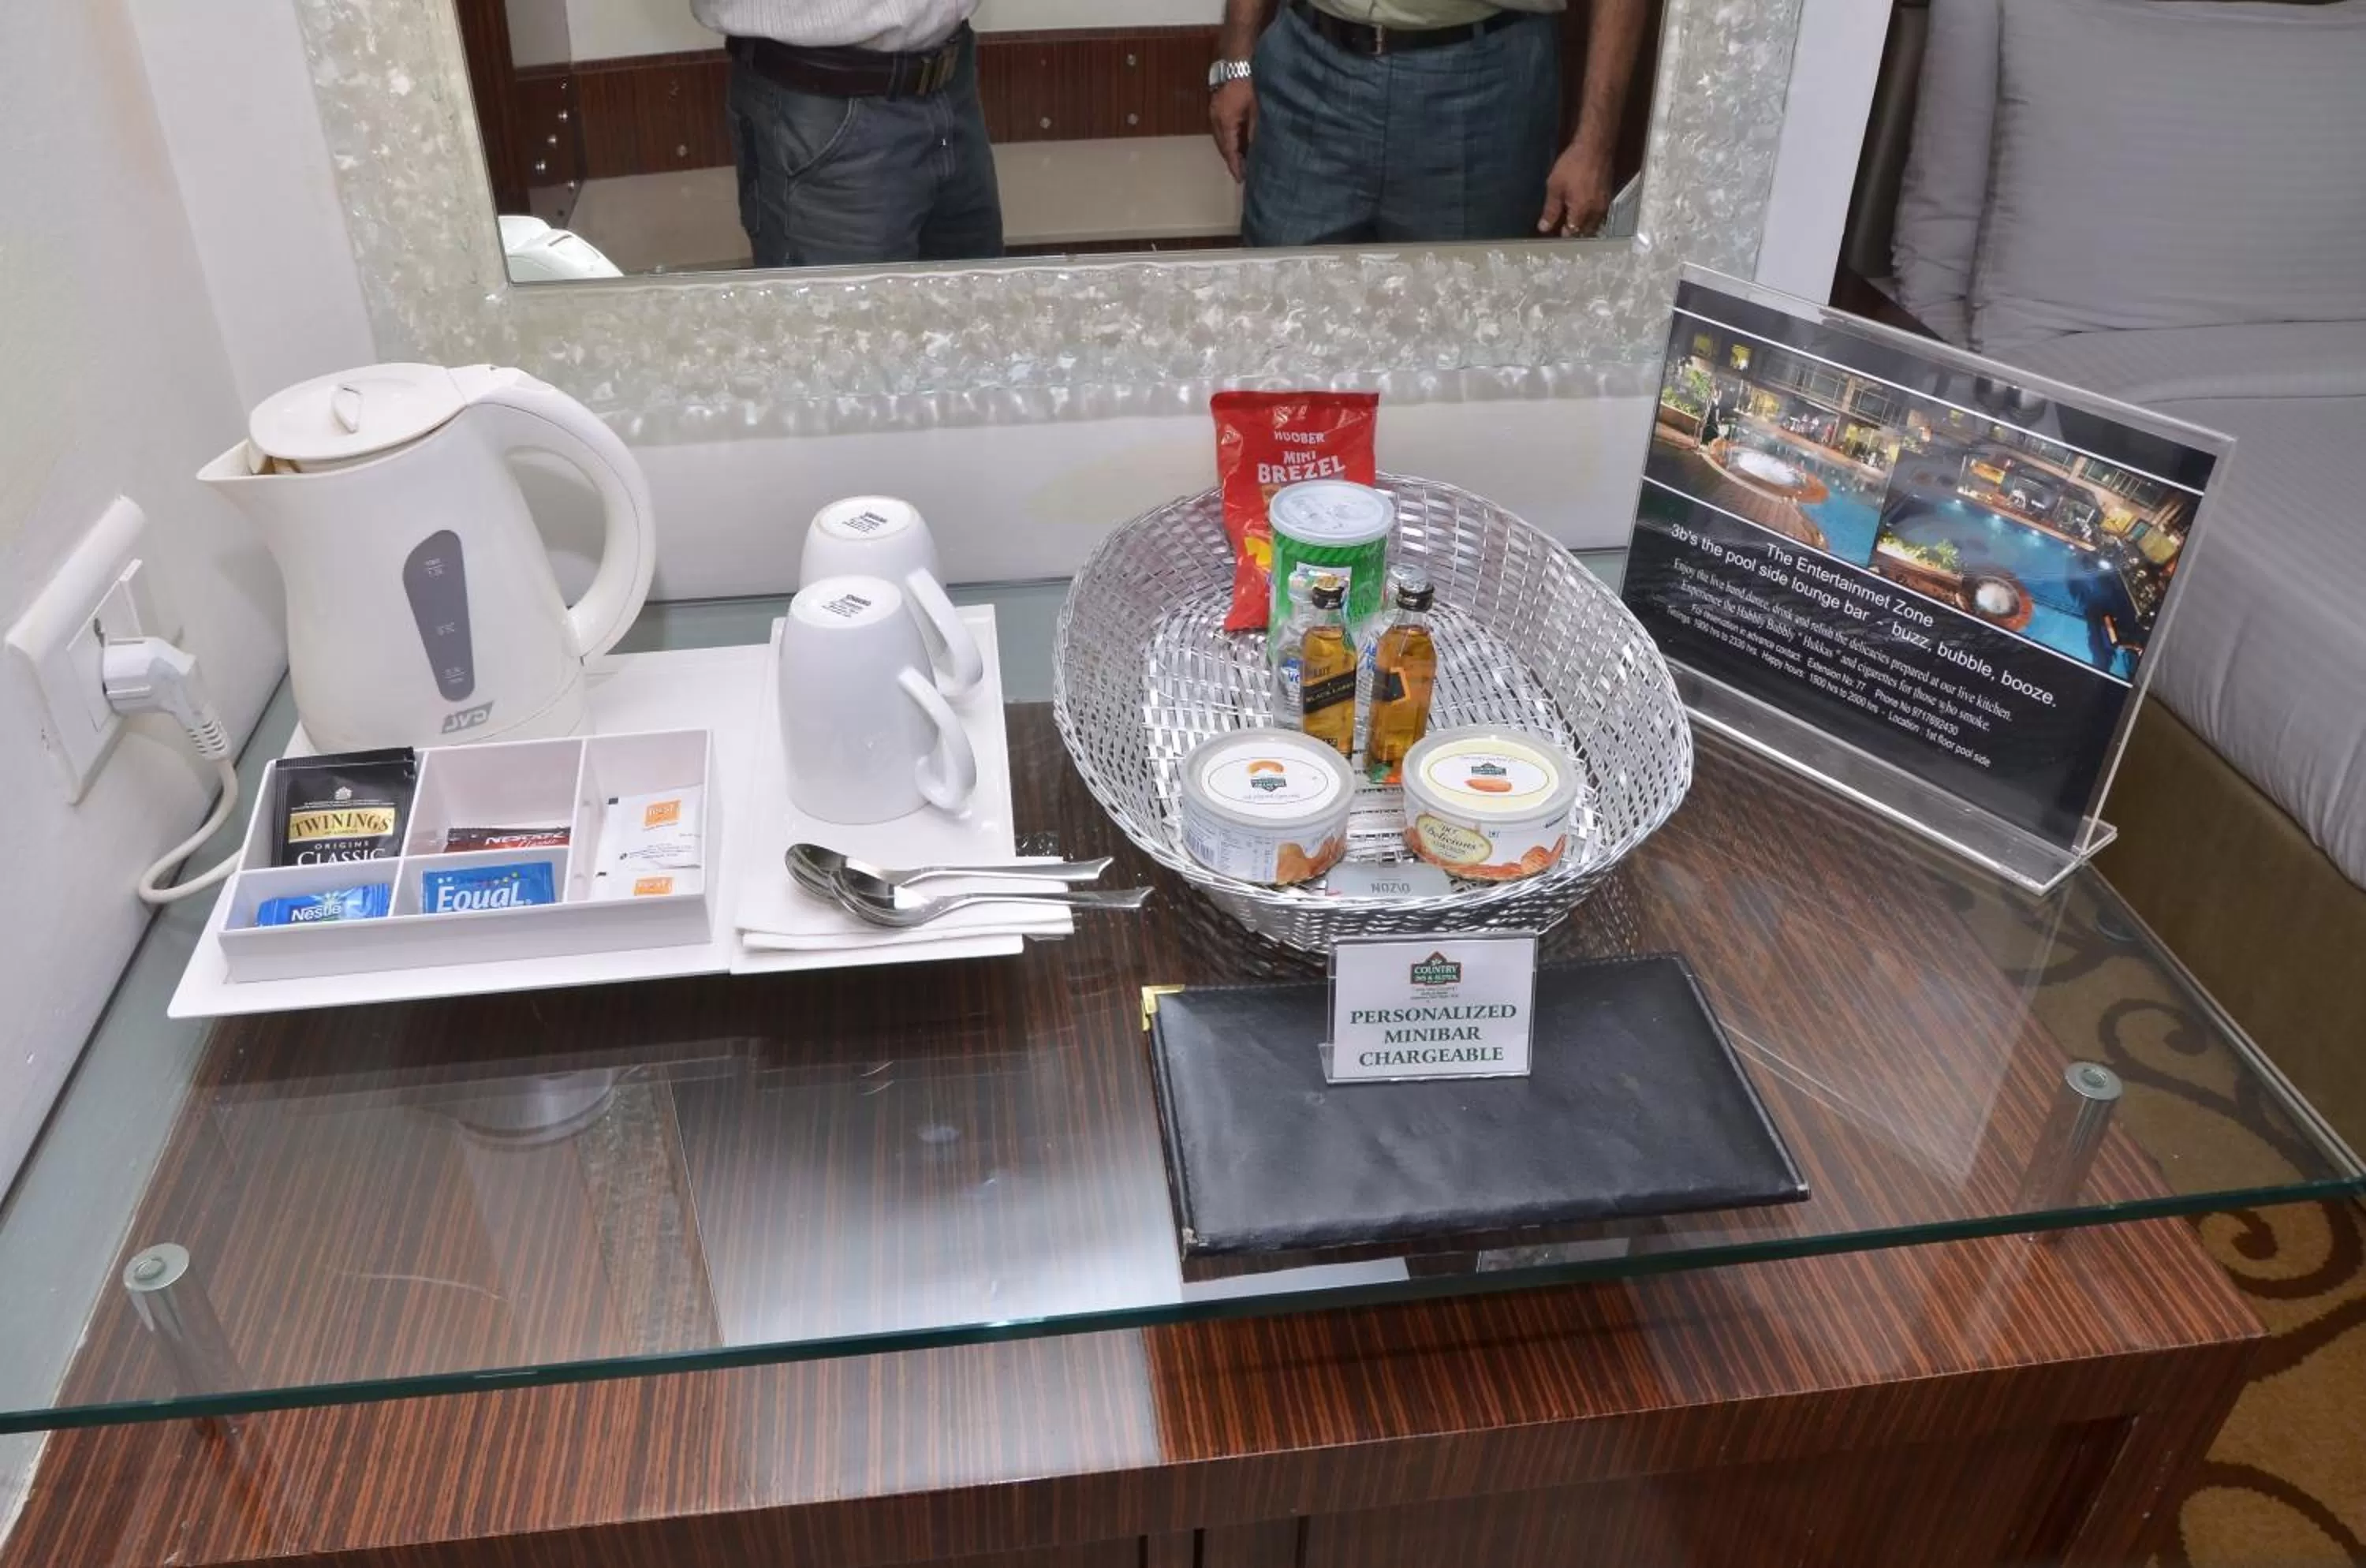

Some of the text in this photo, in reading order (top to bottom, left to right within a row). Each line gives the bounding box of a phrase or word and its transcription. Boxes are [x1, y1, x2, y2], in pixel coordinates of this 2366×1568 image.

[1258, 455, 1346, 483] BREZEL
[1283, 450, 1317, 465] MINI
[1767, 543, 1933, 626] The Entertainmet Zone
[1670, 524, 1697, 545] 3b's
[1702, 537, 1722, 555] the
[1726, 551, 1756, 571] pool
[1759, 566, 1788, 585] side
[1792, 577, 1839, 608] lounge
[1844, 599, 1869, 620] bar
[1892, 622, 1931, 651] buzz,
[1938, 642, 1994, 680] bubble,
[2001, 670, 2055, 707] booze.
[1841, 656, 1857, 668] and
[1899, 680, 1912, 694] for
[1913, 687, 1937, 705] those
[1890, 659, 1929, 681] prepared
[1930, 678, 1939, 687] at
[1940, 682, 1956, 694] our
[1957, 686, 1975, 703] live
[1976, 695, 2011, 720] kitchen.
[1875, 689, 1898, 707] Phone
[295, 812, 390, 837] TWININGS
[1413, 964, 1457, 975] COUNTRY
[1349, 1004, 1517, 1025] PERSONALIZED
[1384, 1026, 1483, 1044] MINIBAR
[1359, 1047, 1504, 1067] CHARGEABLE
